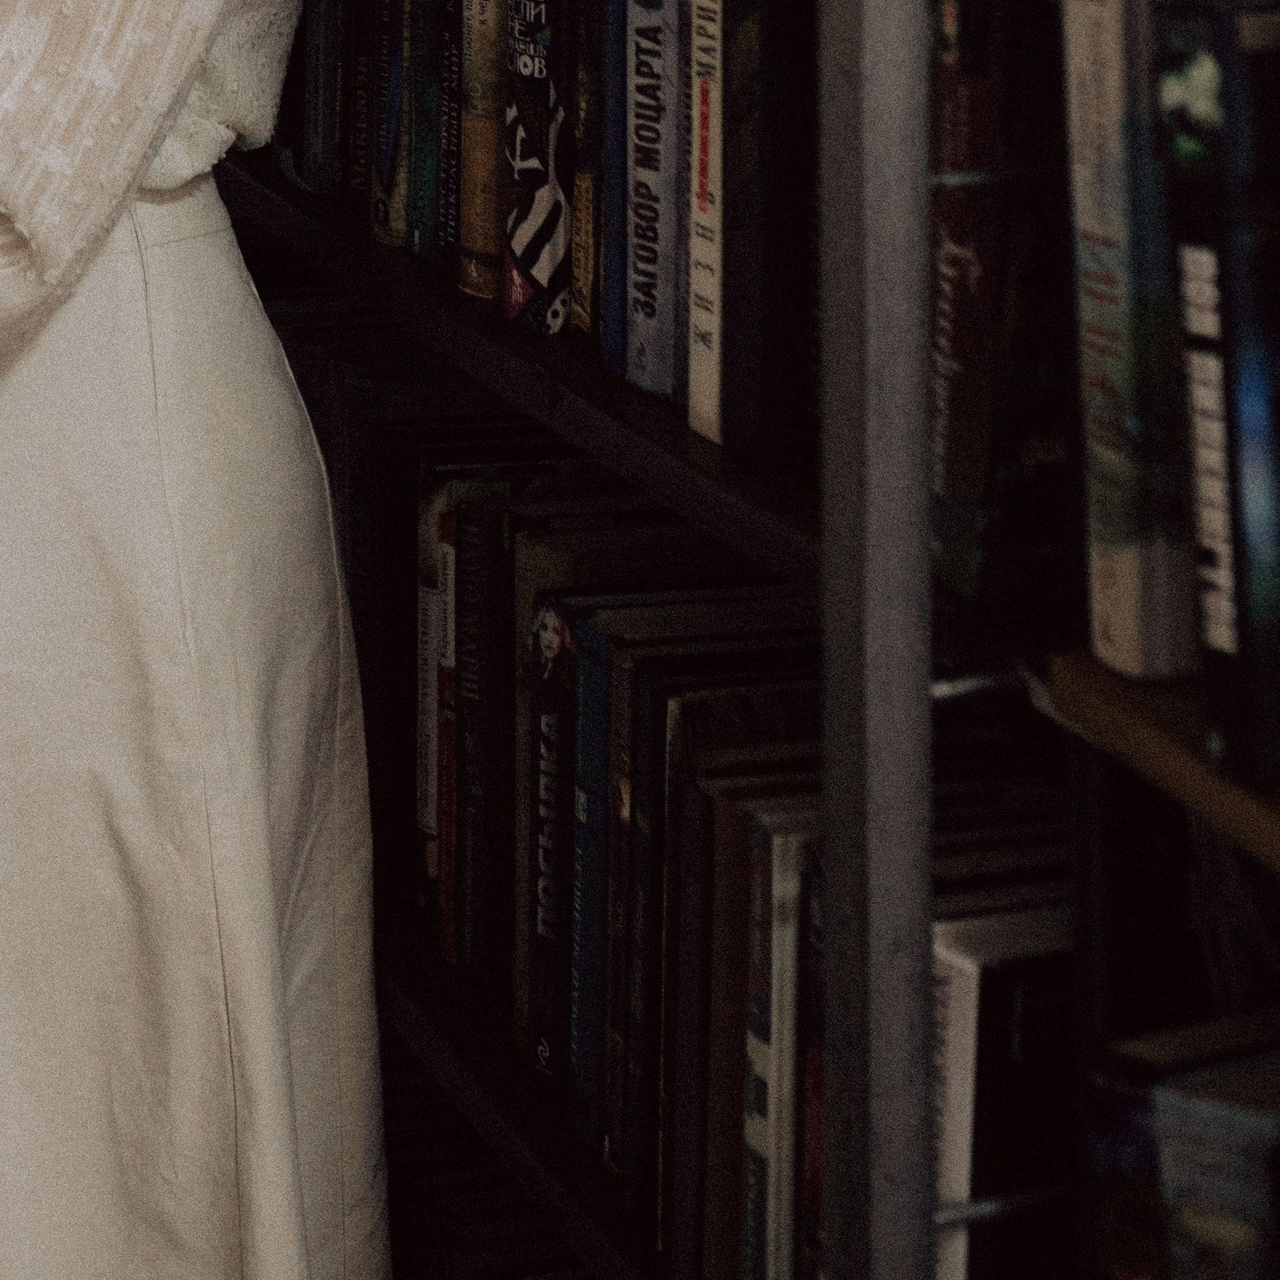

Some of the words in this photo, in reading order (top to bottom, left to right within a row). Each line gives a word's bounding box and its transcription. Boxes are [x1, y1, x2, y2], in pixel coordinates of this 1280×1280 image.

[634, 24, 663, 171] МОЦАРТА
[632, 181, 657, 320] ЗАГОВОР
[534, 711, 559, 940] ПОСЫЛКА
